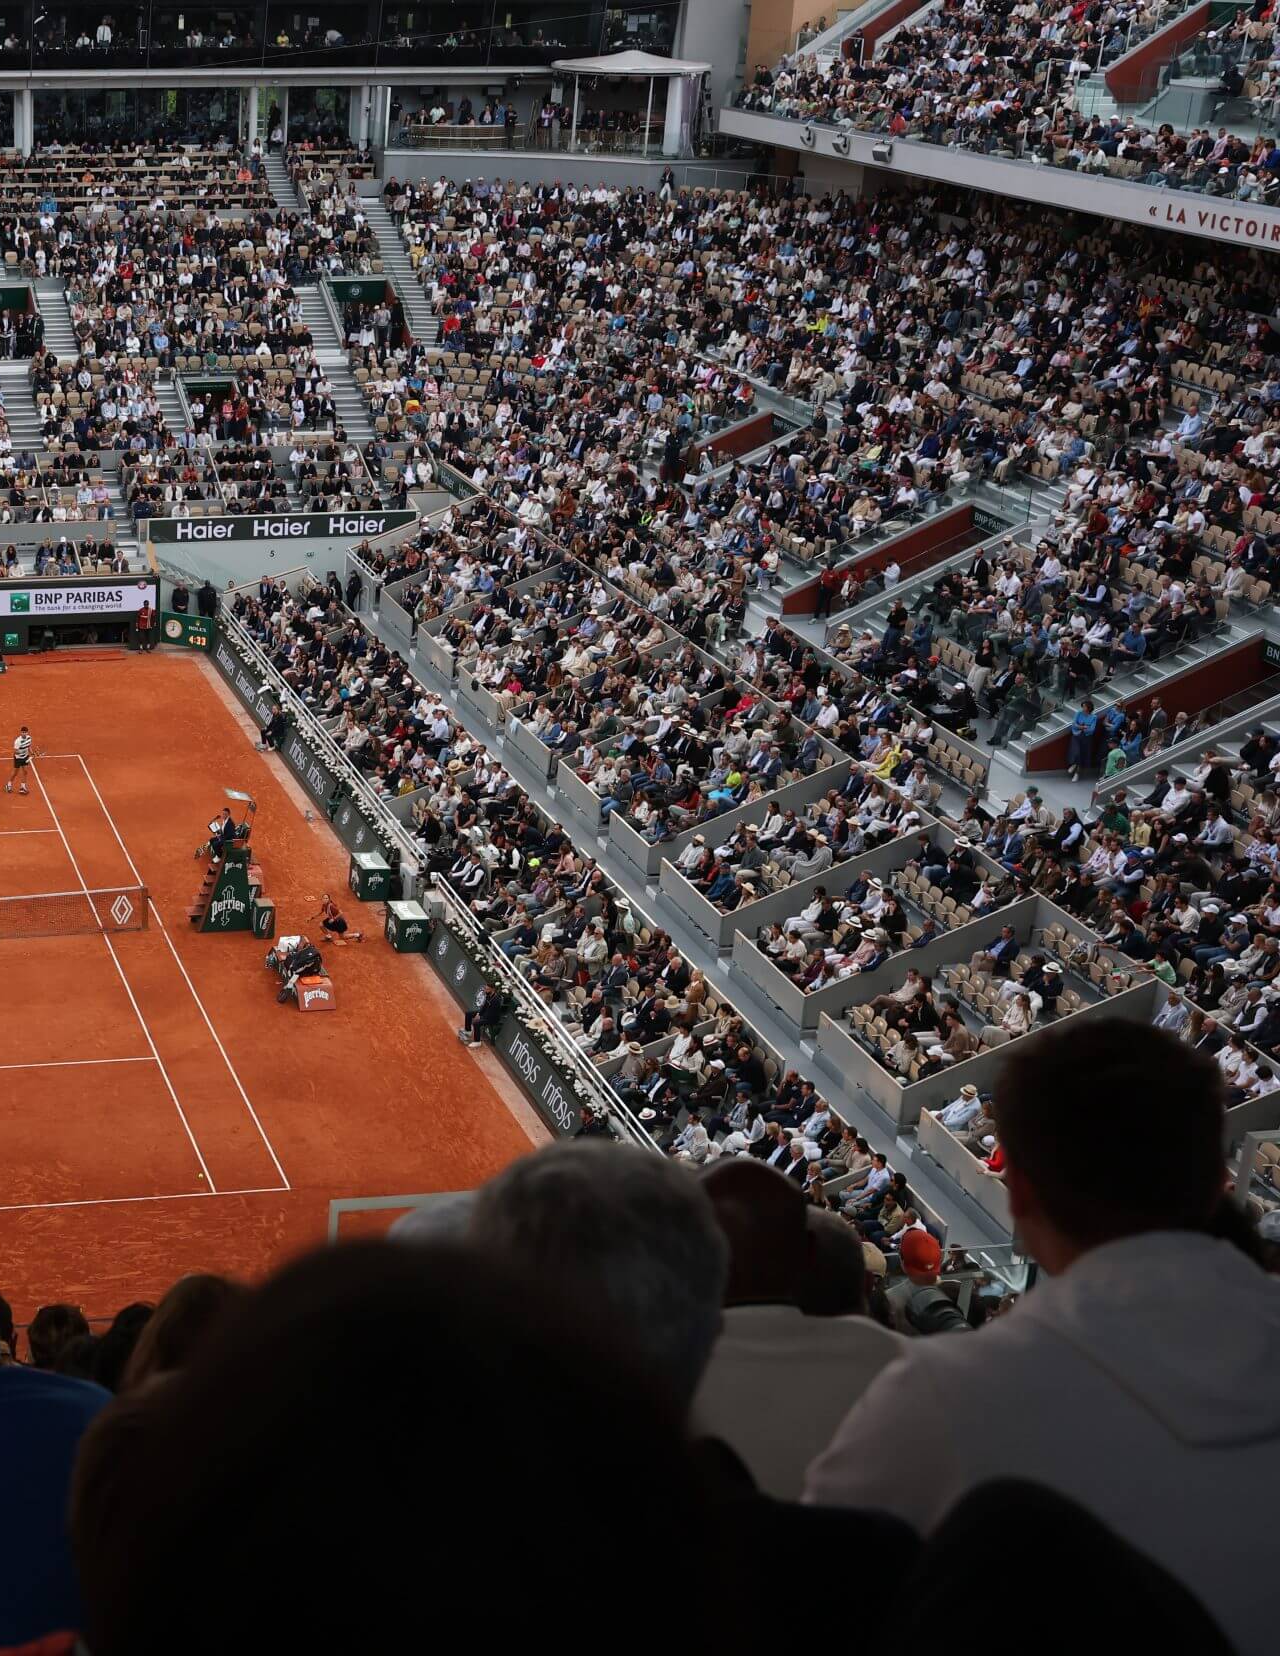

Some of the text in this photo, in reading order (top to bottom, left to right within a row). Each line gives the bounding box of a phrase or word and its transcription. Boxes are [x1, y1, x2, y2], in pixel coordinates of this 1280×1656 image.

[1166, 203, 1186, 225] LA
[176, 520, 234, 540] Haier
[253, 518, 311, 537] Haier
[328, 515, 386, 535] Haier
[34, 590, 123, 605] BNP PARIBAS
[508, 1031, 541, 1083] Infosys
[541, 1074, 575, 1130] Infosys
